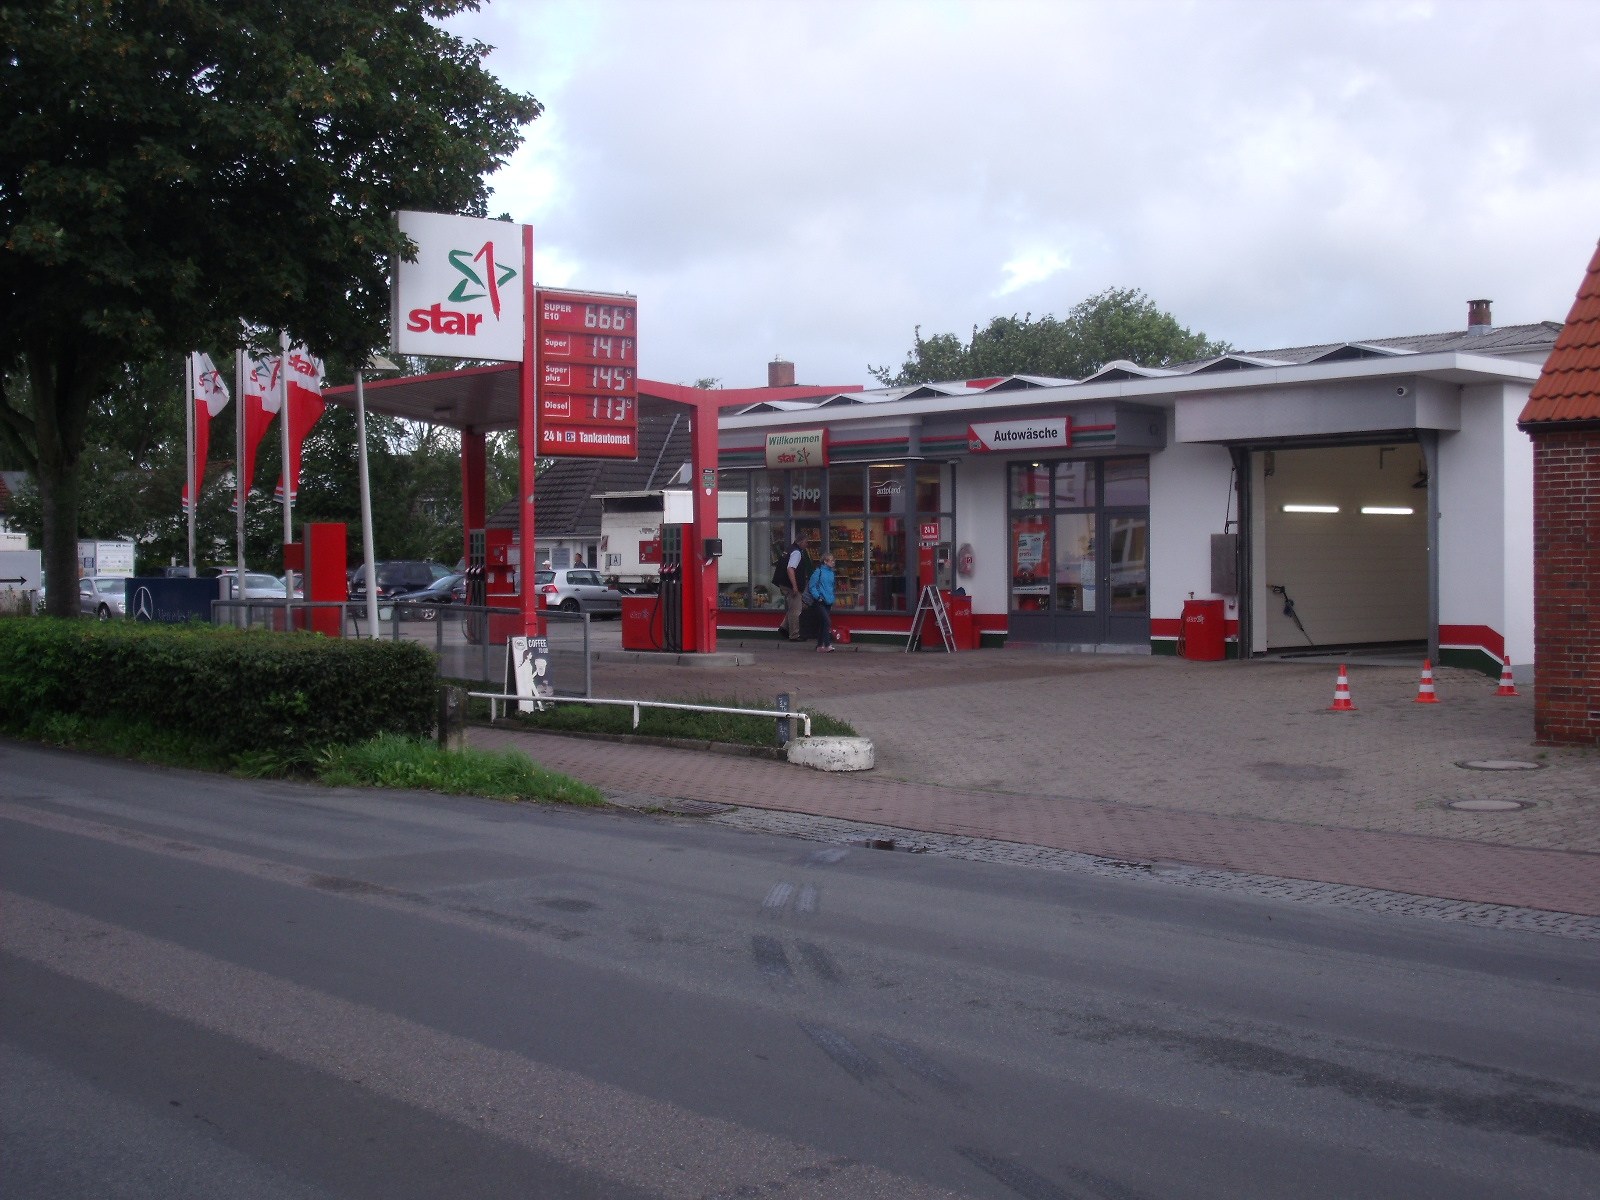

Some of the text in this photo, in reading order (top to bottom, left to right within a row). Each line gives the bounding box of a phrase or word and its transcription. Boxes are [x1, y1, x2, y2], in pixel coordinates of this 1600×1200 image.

[544, 303, 572, 313] SUPER
[407, 303, 482, 336] star
[544, 312, 560, 321] E10
[545, 338, 567, 348] Super
[545, 365, 568, 375] Super
[545, 374, 561, 382] plus
[544, 401, 568, 410] Diesel
[543, 431, 554, 441] 24
[556, 431, 562, 442] h
[579, 432, 630, 445] Tankautomat
[994, 427, 1058, 442] Autowäsche
[768, 435, 820, 446] Willkommen
[777, 452, 796, 463] star
[792, 485, 820, 504] Shop
[876, 486, 902, 495] autoland
[924, 526, 931, 534] 24
[613, 554, 618, 563] A
[528, 639, 547, 648] COFFEE
